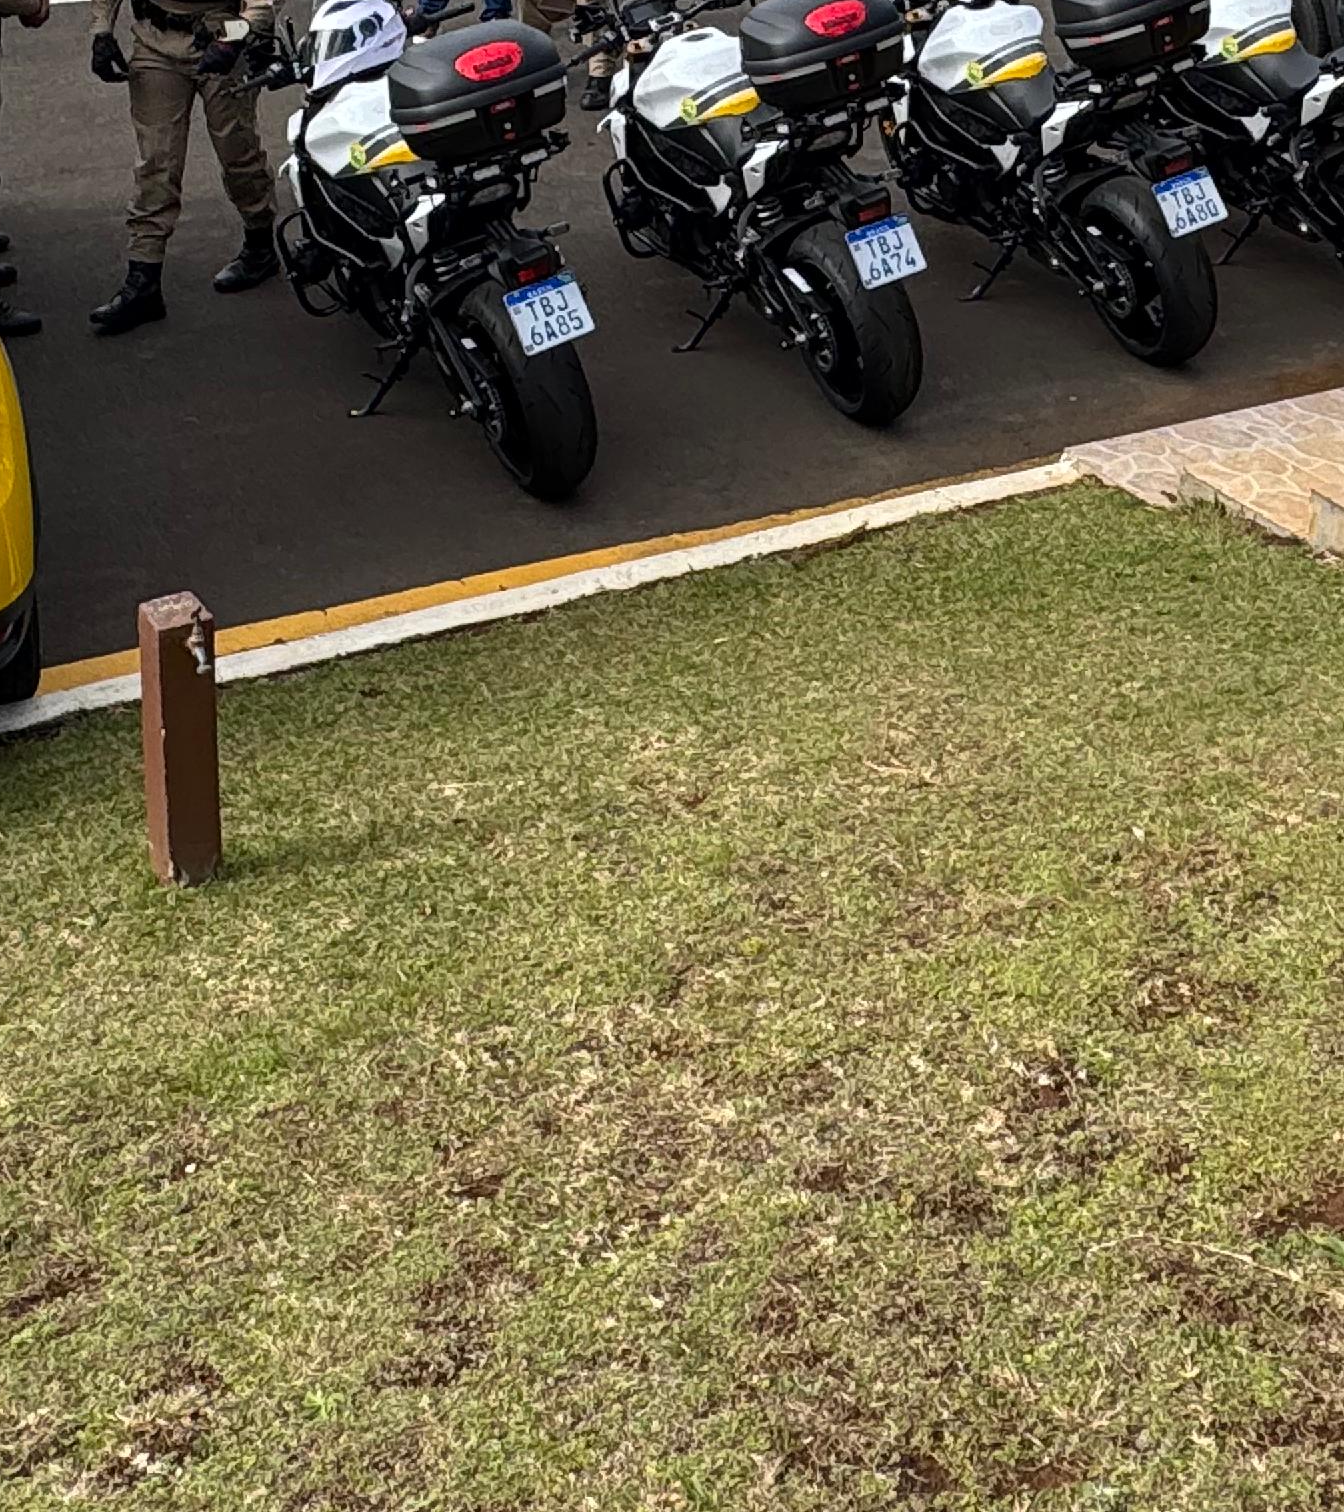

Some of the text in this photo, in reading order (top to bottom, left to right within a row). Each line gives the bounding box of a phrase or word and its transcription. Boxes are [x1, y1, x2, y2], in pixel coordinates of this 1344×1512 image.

[1169, 182, 1206, 209] TBJ
[865, 230, 904, 259] TBJ
[869, 249, 917, 281] 6A74
[524, 289, 569, 322] TBJ
[530, 308, 584, 346] 6A85
